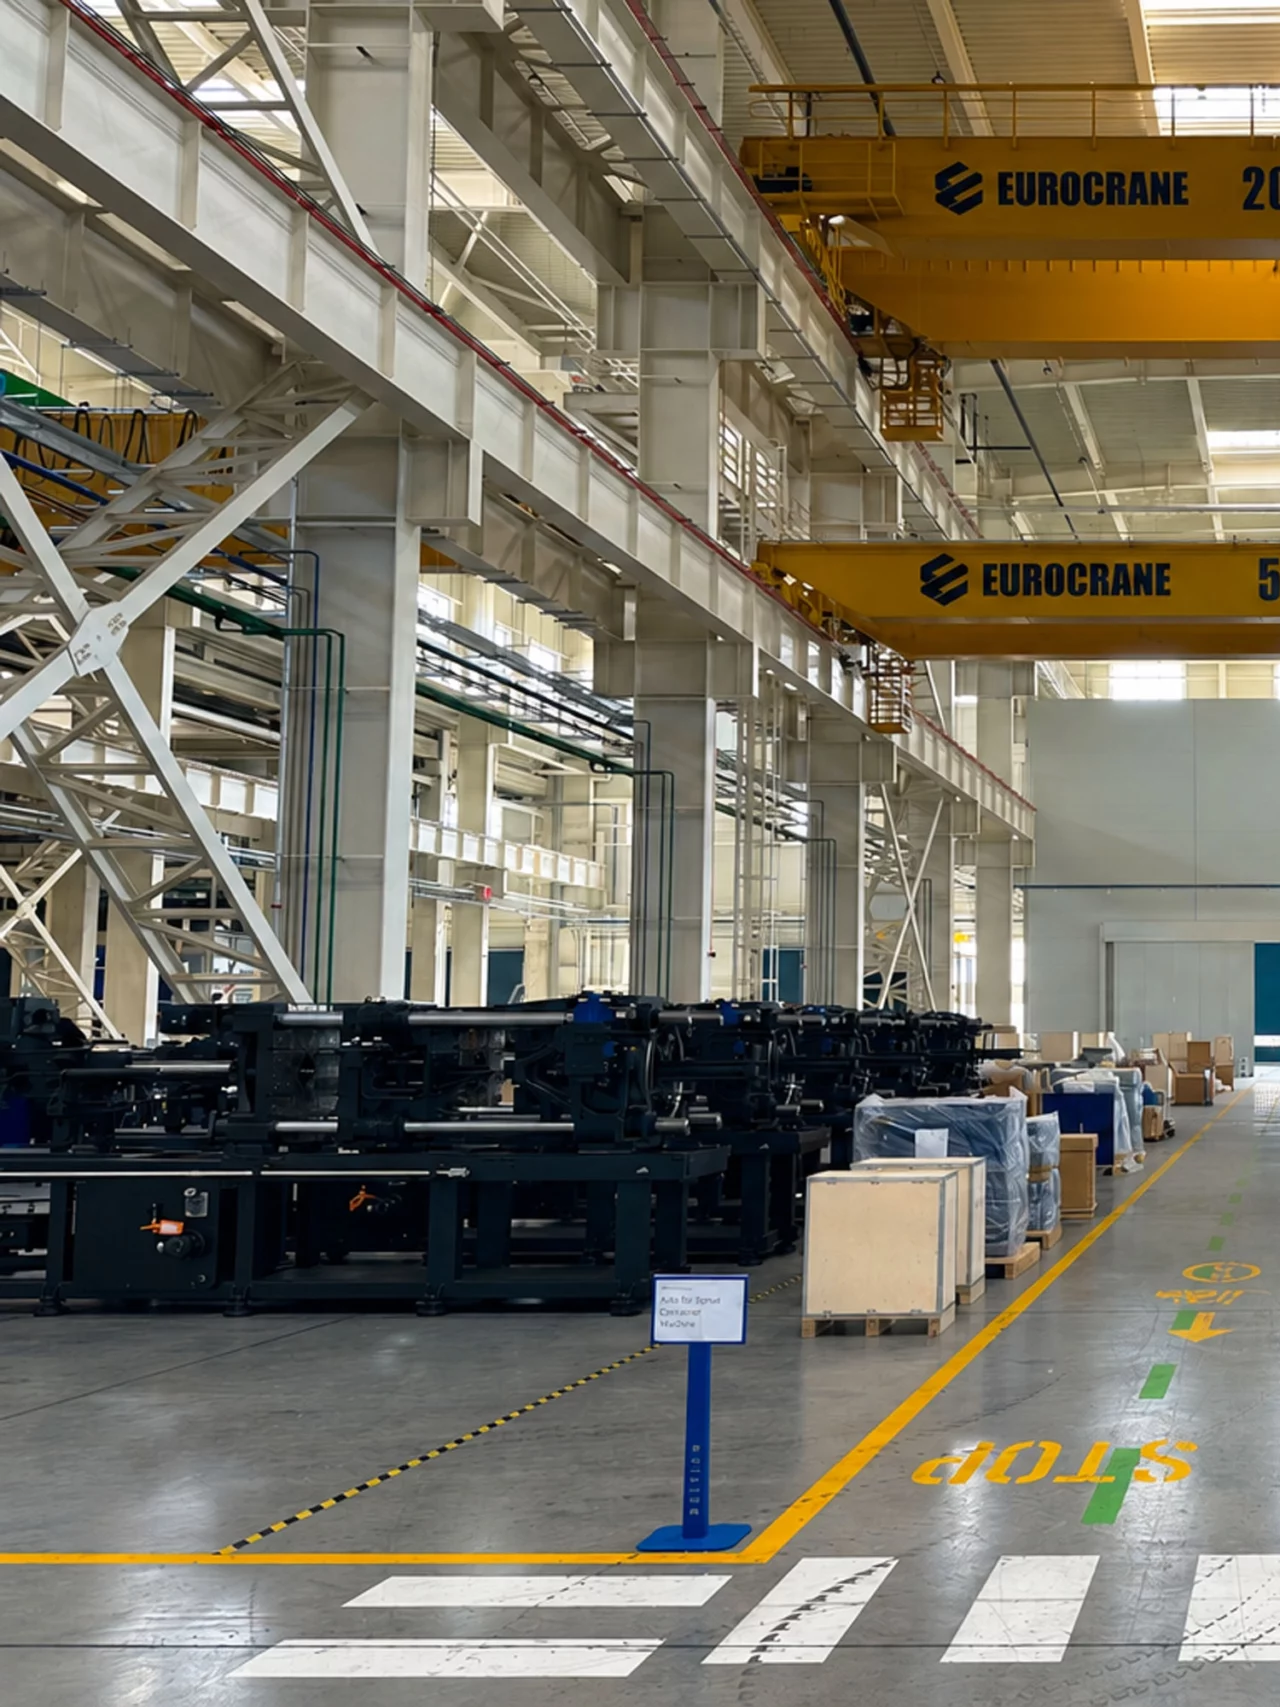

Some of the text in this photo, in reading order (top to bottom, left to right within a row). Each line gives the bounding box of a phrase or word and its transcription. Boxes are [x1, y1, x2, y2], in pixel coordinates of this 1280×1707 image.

[998, 171, 1189, 207] EUROCRANE
[983, 562, 1171, 597] EUROCRANE
[911, 1438, 1198, 1485] STOP
